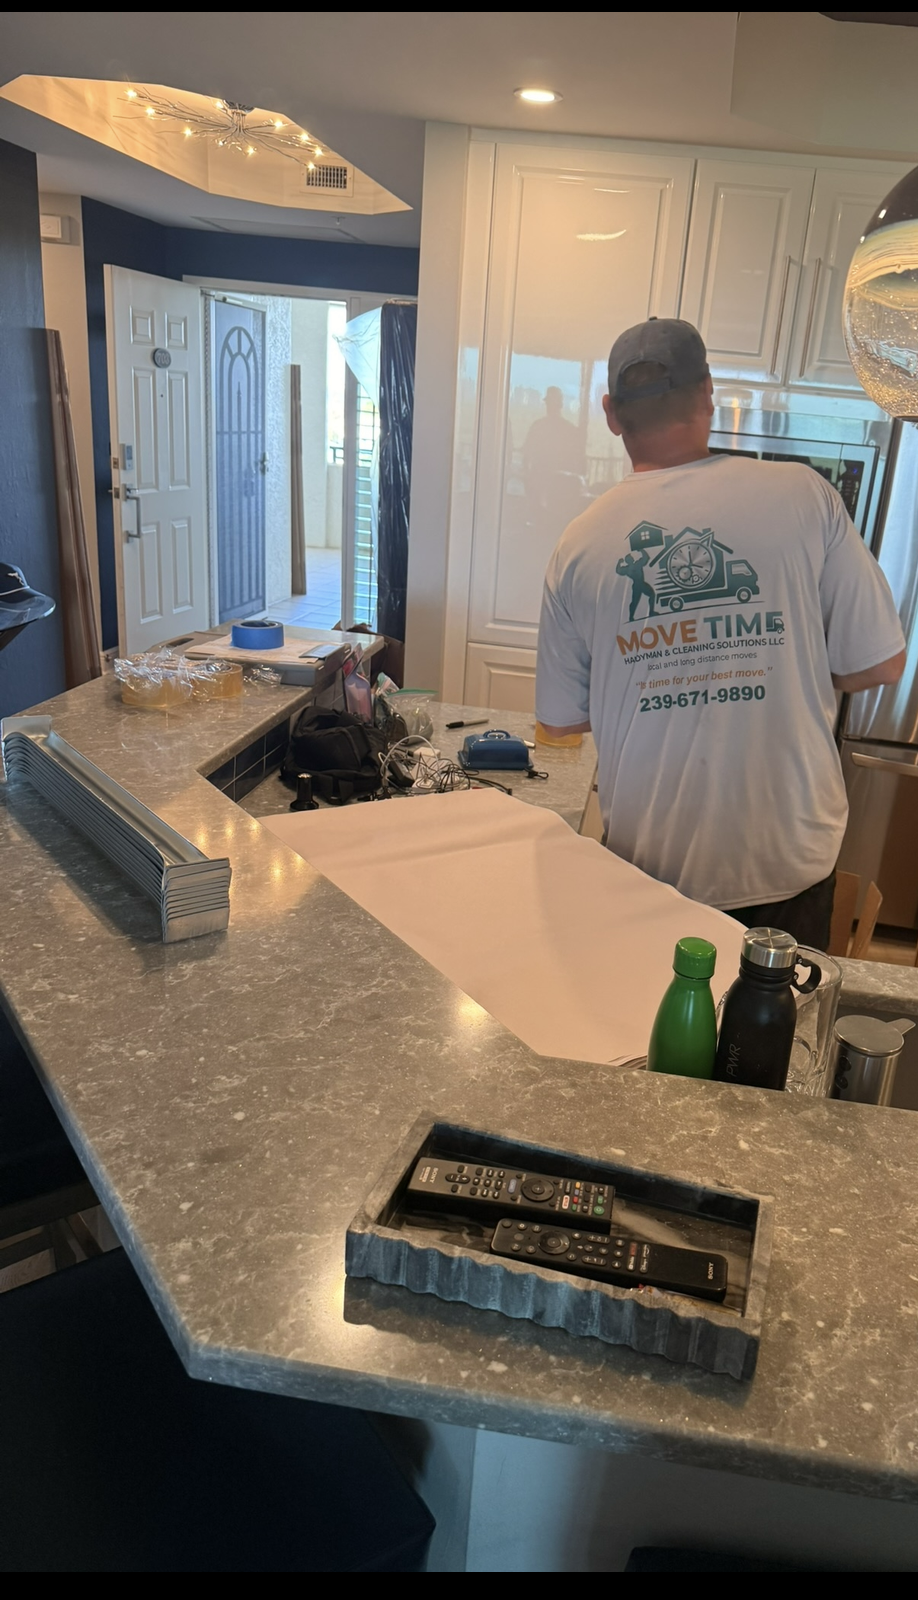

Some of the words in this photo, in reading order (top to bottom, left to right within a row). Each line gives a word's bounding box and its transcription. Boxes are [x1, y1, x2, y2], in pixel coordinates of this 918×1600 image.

[616, 619, 698, 656] MOVE
[703, 611, 786, 640] TIME
[664, 649, 671, 657] &
[672, 642, 716, 655] CLEANING
[716, 638, 767, 650] SOLUTIONS
[768, 637, 785, 646] LLC
[663, 659, 679, 668] and
[680, 658, 696, 667] long
[697, 654, 730, 664] distance
[731, 652, 758, 660] moves
[649, 679, 670, 689] time
[672, 675, 685, 685] for
[686, 673, 709, 686] your
[711, 669, 733, 680] best
[640, 684, 766, 712] 239-671-9890
[726, 1043, 741, 1077] PWR
[707, 1261, 715, 1280] SONY
